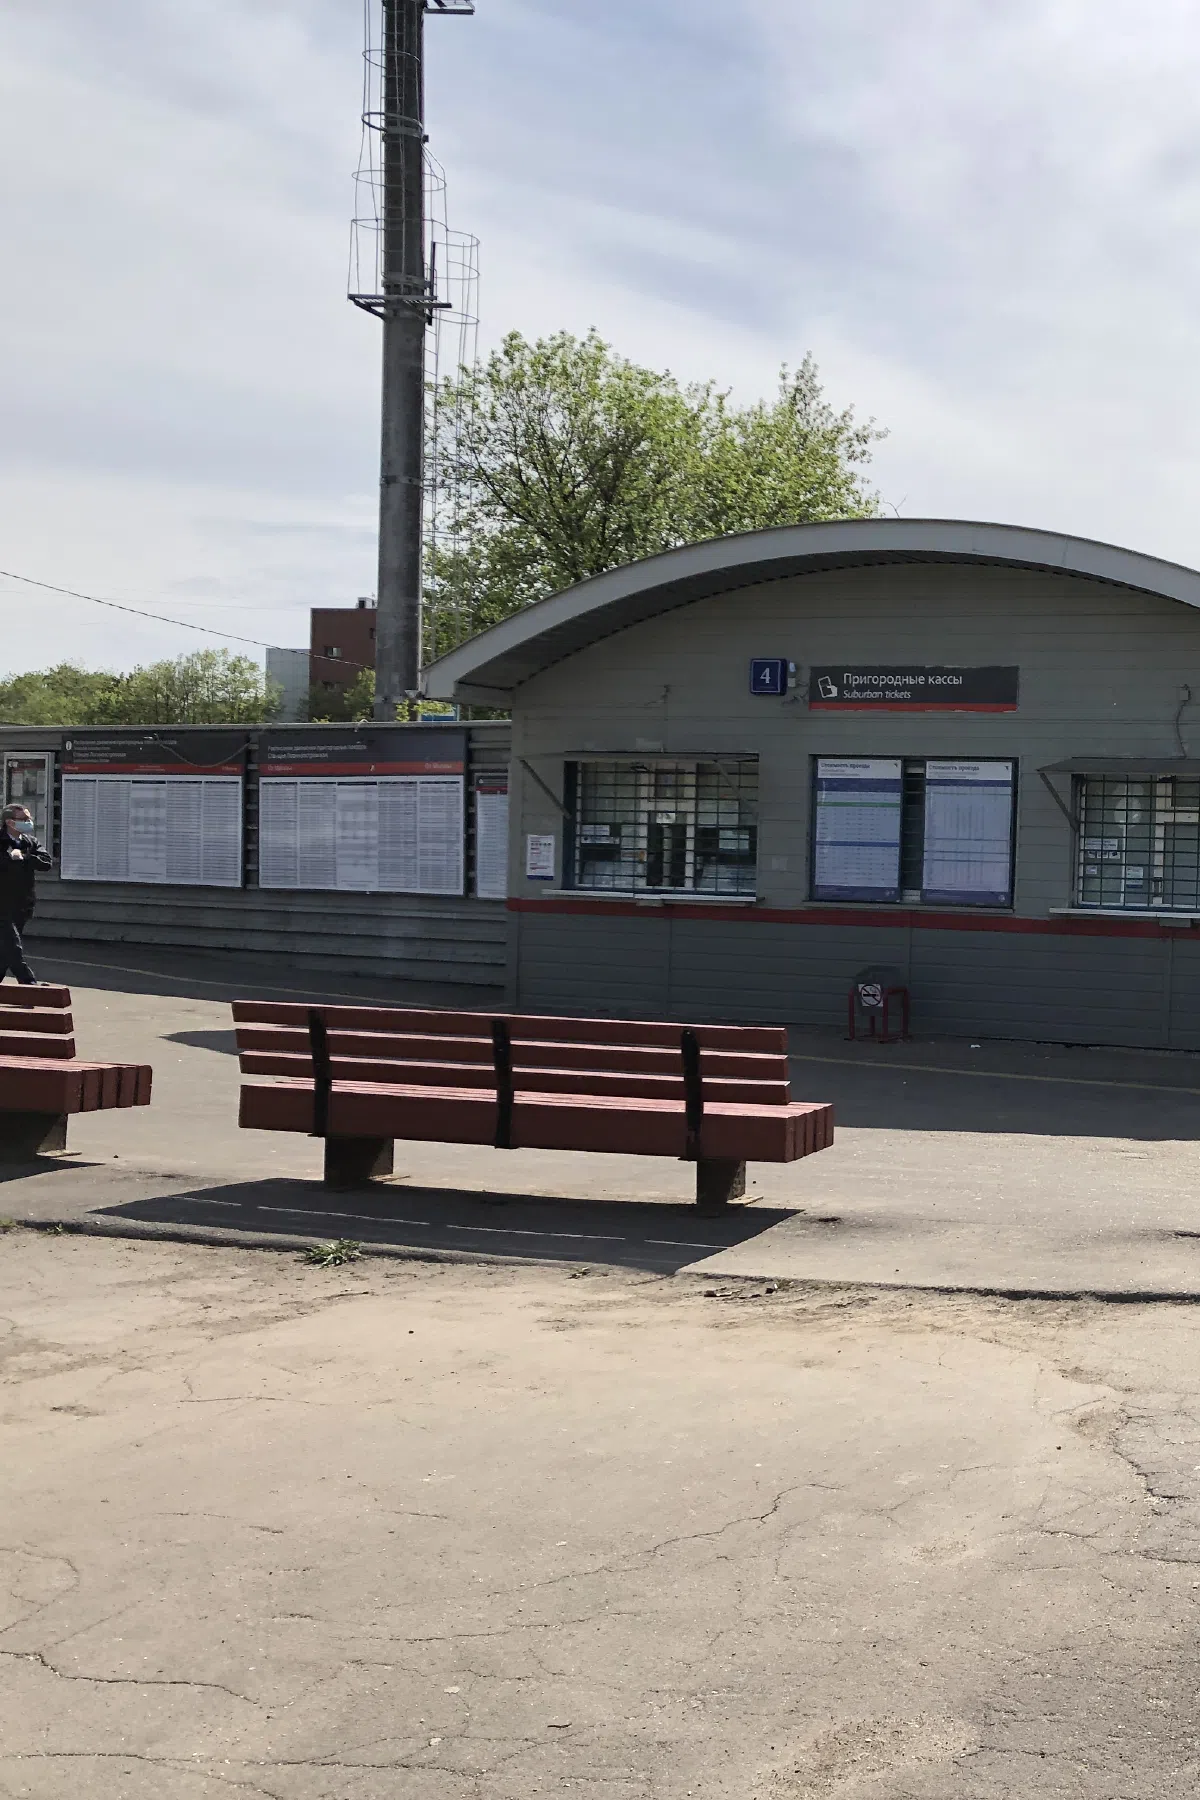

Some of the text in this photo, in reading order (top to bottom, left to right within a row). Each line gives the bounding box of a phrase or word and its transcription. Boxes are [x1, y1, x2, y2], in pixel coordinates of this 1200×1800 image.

[760, 667, 771, 684] 4
[843, 672, 963, 688] Пригородные кассы
[843, 689, 912, 699] Suburban tickets
